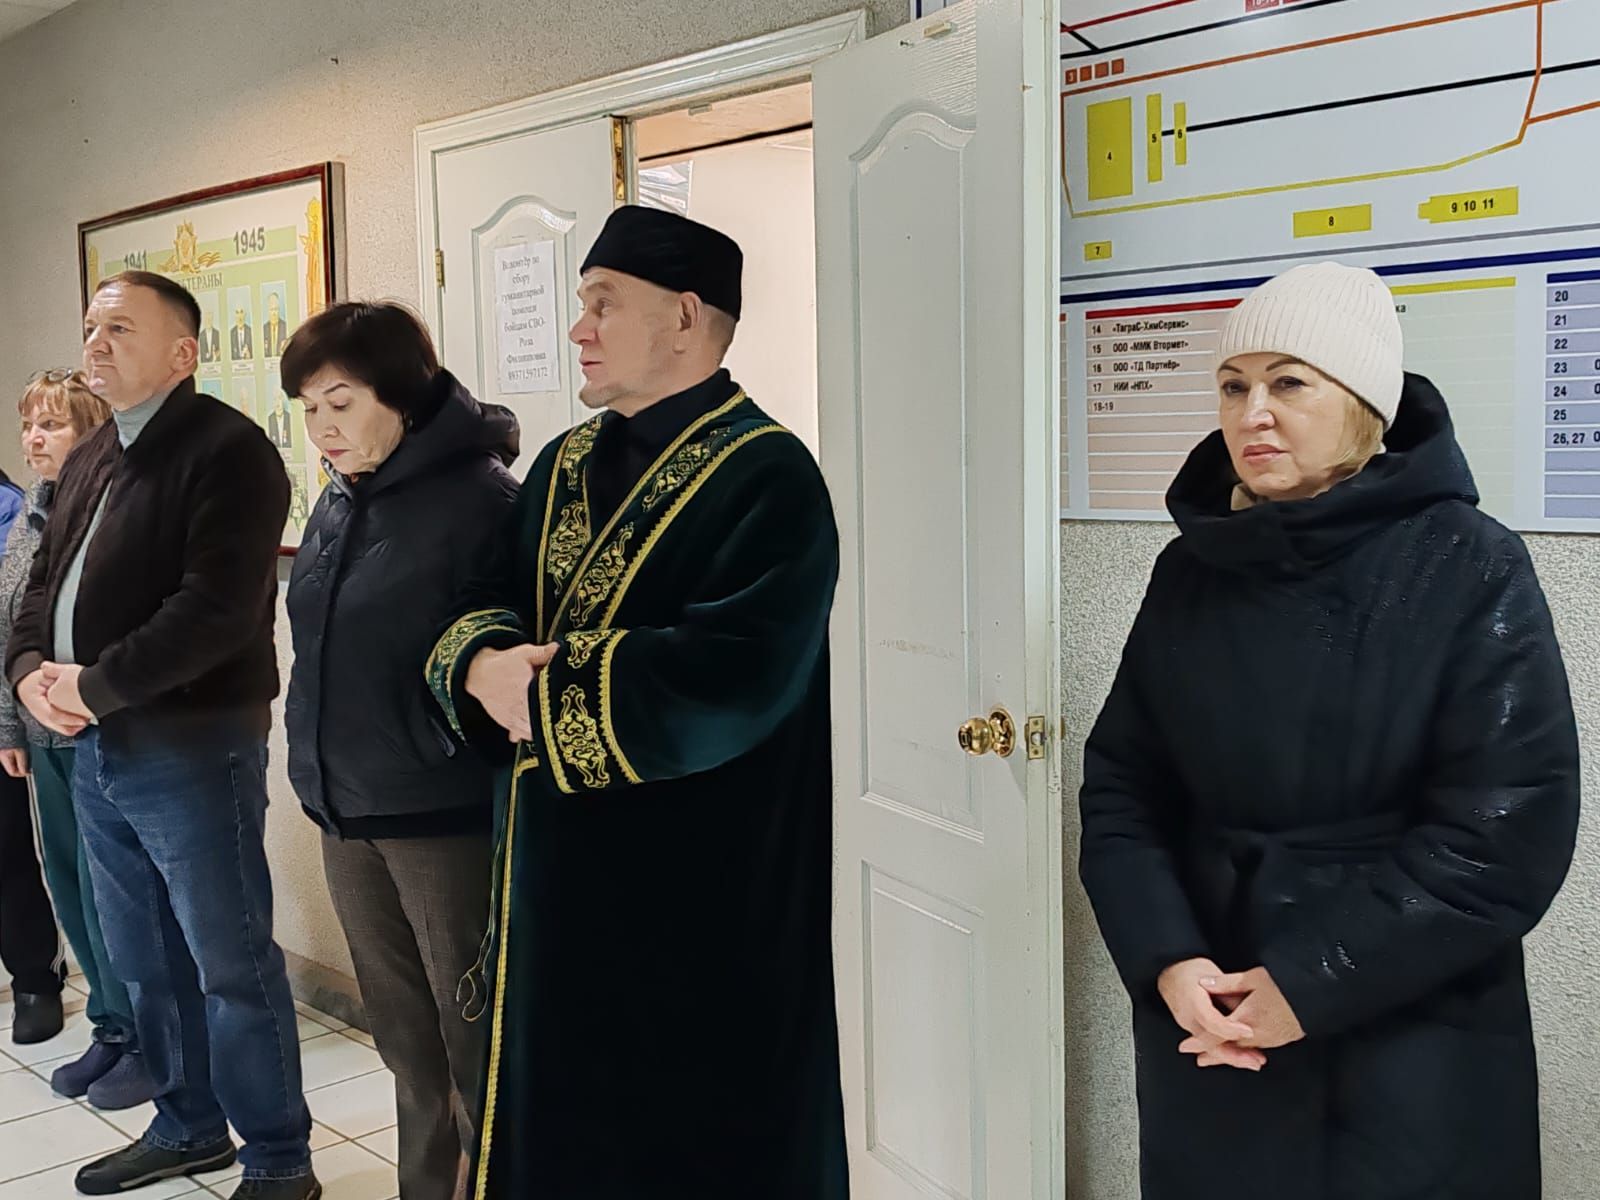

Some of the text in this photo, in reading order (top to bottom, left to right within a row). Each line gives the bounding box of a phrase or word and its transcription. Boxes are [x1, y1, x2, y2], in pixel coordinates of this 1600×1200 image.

[1151, 133, 1157, 143] 5
[1177, 129, 1183, 139] 6
[1107, 152, 1112, 161] 4
[1451, 198, 1495, 213] 9 10 11
[1328, 216, 1335, 226] 8
[233, 227, 266, 255] 1945
[1095, 246, 1101, 256] 7
[1554, 290, 1568, 302] 20
[1554, 314, 1567, 326] 21
[1092, 324, 1101, 334] 14
[1093, 344, 1101, 354] 15
[1113, 342, 1128, 353] ООО
[1153, 340, 1189, 351] Втормет»
[1554, 338, 1568, 349] 22
[1113, 362, 1128, 372] ООО
[1553, 362, 1567, 373] 23
[1093, 382, 1102, 392] 17
[1113, 381, 1129, 392] НИИ
[1553, 386, 1567, 397] 24
[1553, 409, 1566, 420] 25
[1552, 433, 1570, 445] 26,
[1571, 432, 1585, 444] 27
